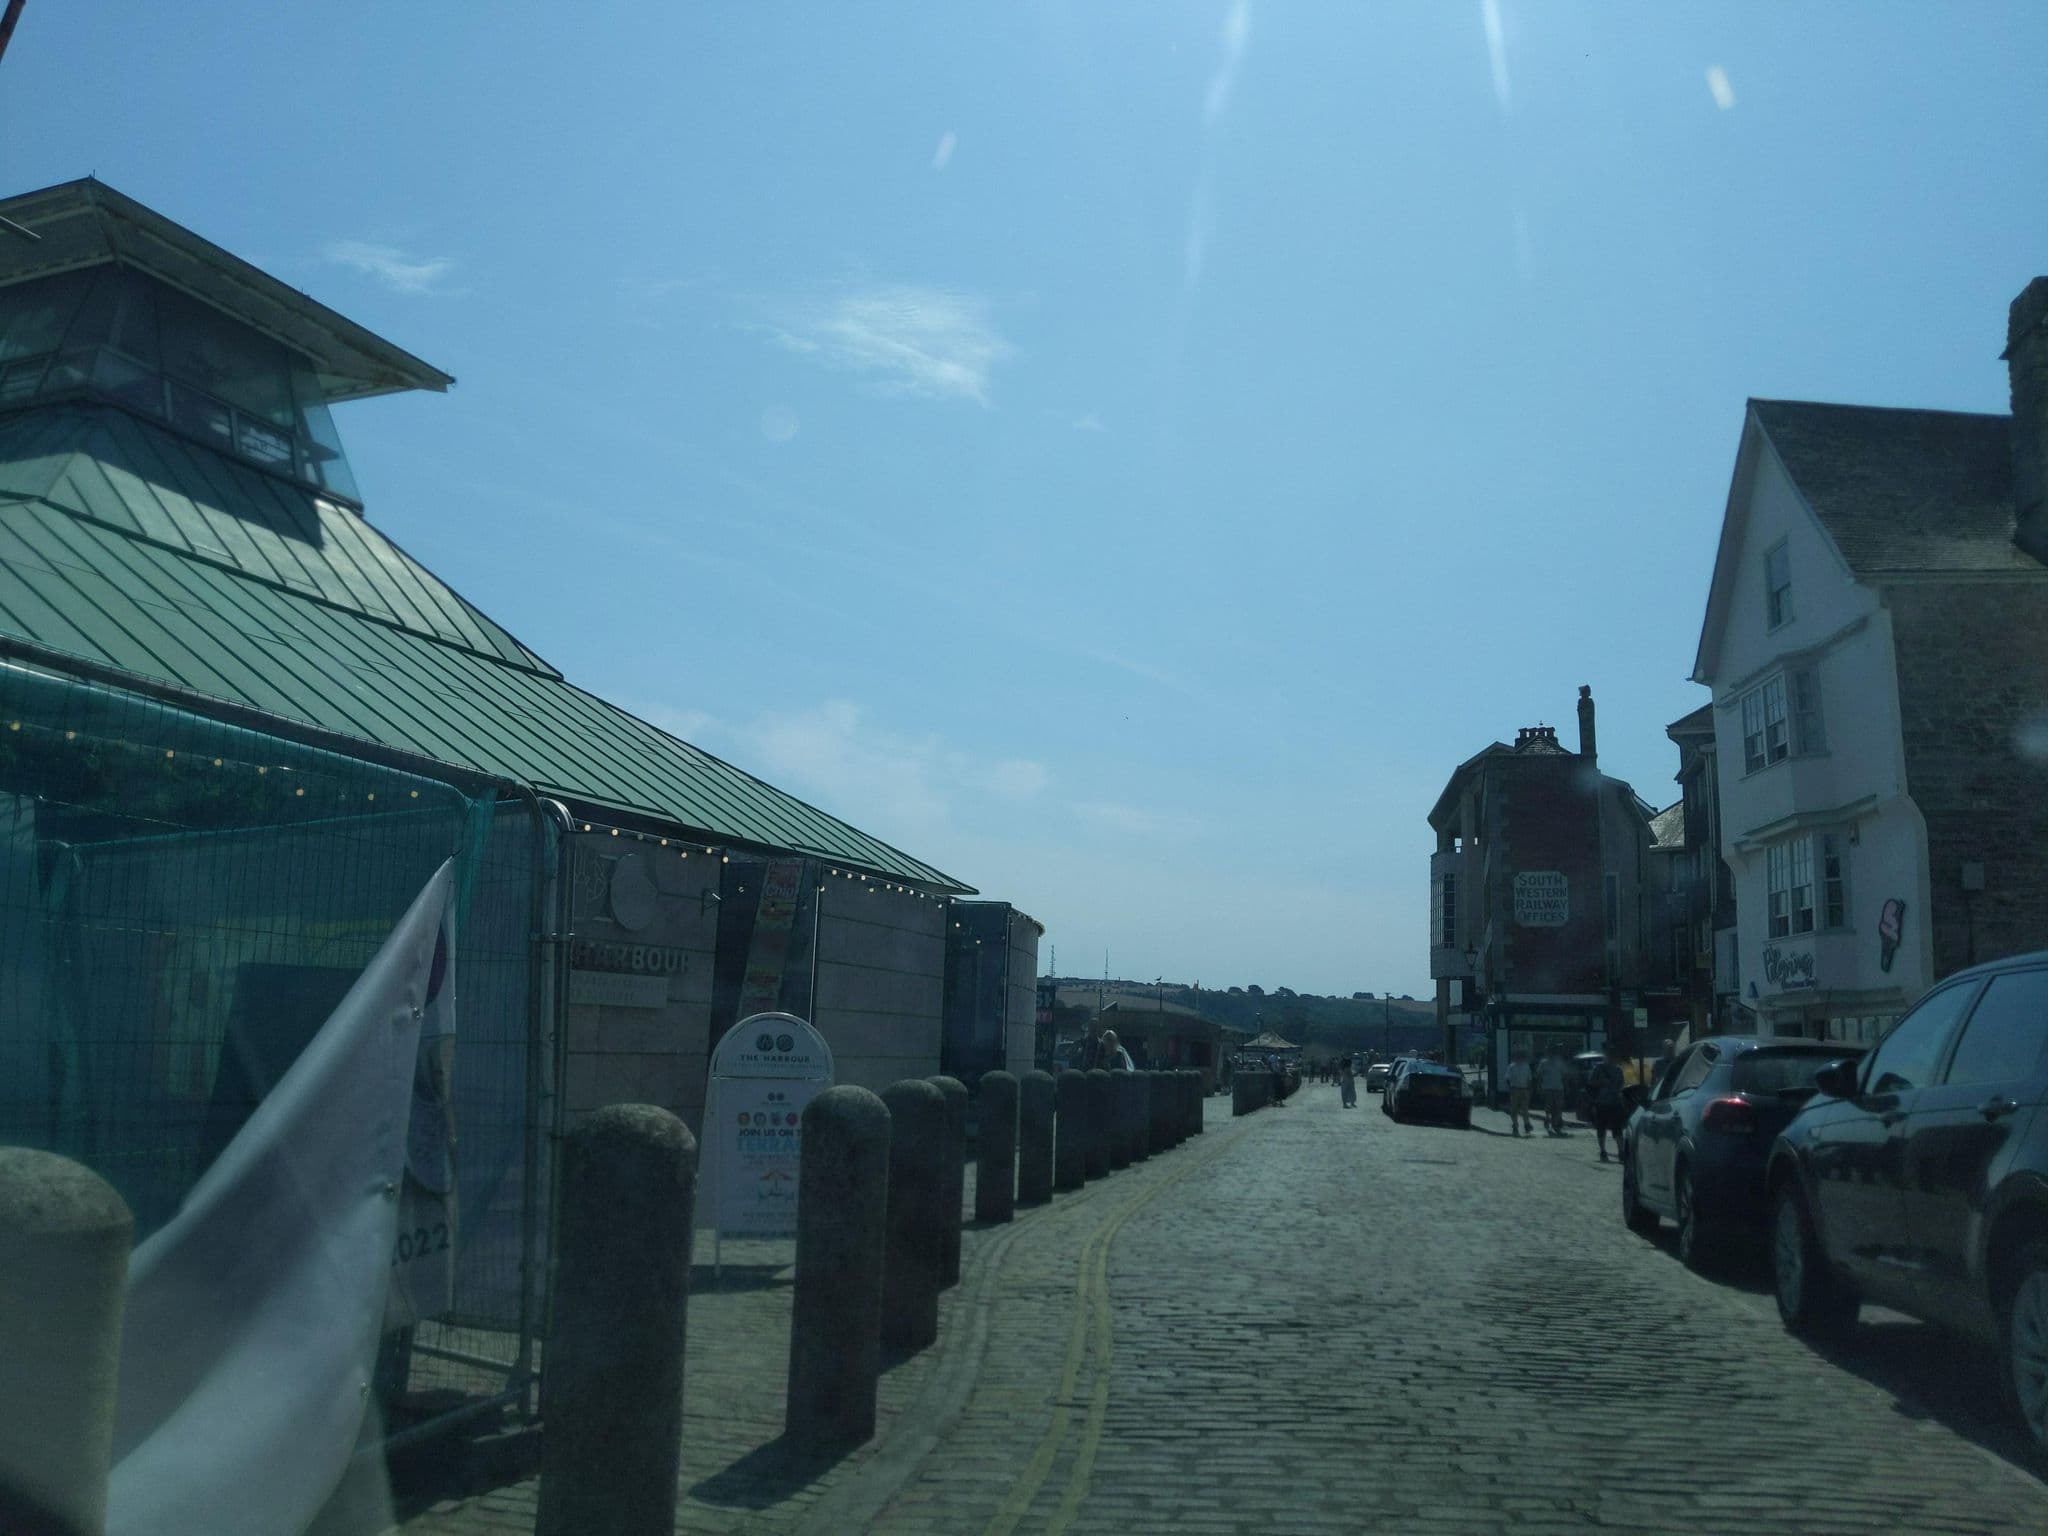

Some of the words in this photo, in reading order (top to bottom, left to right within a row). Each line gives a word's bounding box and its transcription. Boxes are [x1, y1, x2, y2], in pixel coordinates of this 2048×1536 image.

[1518, 873, 1562, 886] SOUTH
[1516, 887, 1567, 898] WESTERN
[1516, 899, 1567, 910] RAILWAY
[1518, 911, 1566, 921] OFFICES
[740, 1053, 759, 1062] THE
[763, 1054, 810, 1063] HARBOUR
[737, 1128, 761, 1137] JOIN
[763, 1128, 776, 1137] US
[778, 1128, 794, 1137] ON
